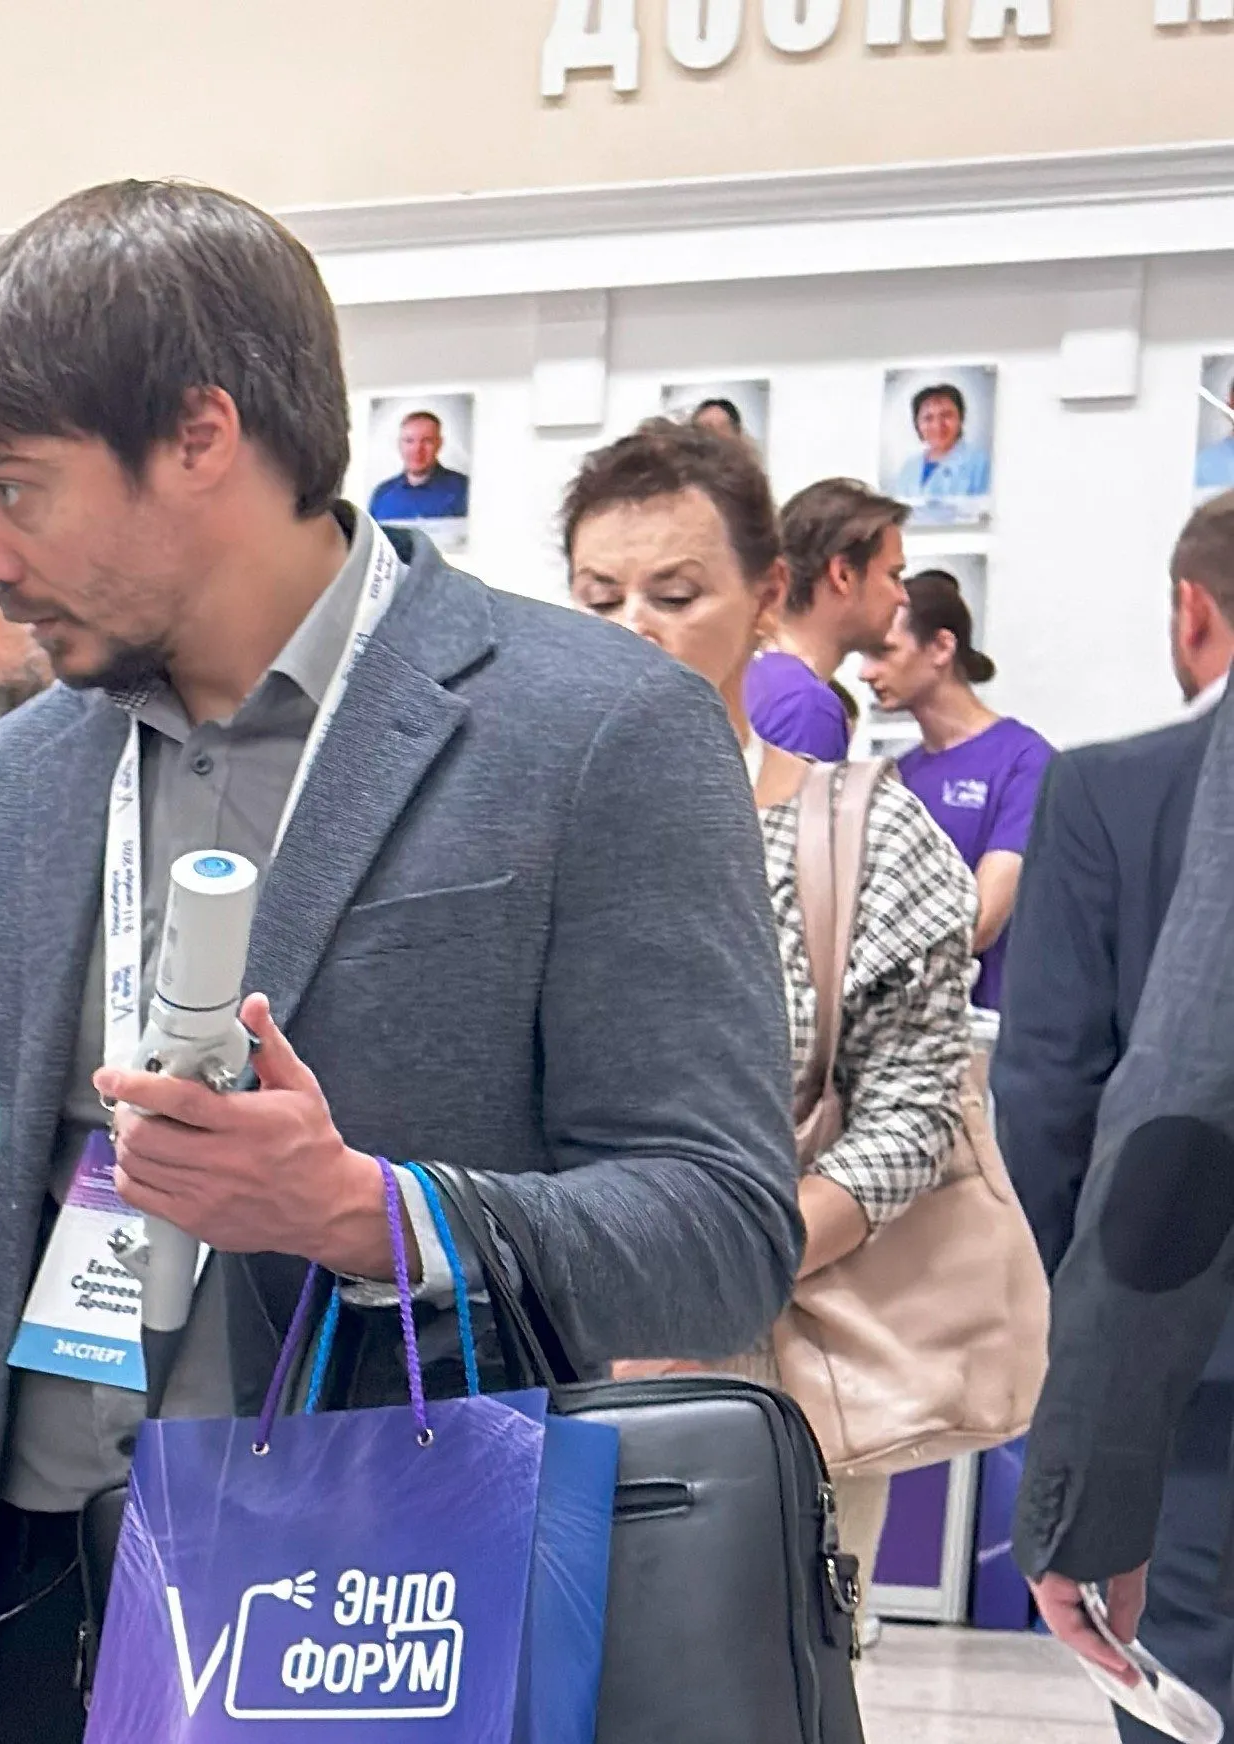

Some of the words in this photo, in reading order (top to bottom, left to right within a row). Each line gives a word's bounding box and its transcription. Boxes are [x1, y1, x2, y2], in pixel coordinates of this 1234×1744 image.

[53, 1337, 127, 1366] ЭКСПЕРТ
[333, 1569, 456, 1628] ЭНДО
[281, 1637, 449, 1694] ФОРУМ
